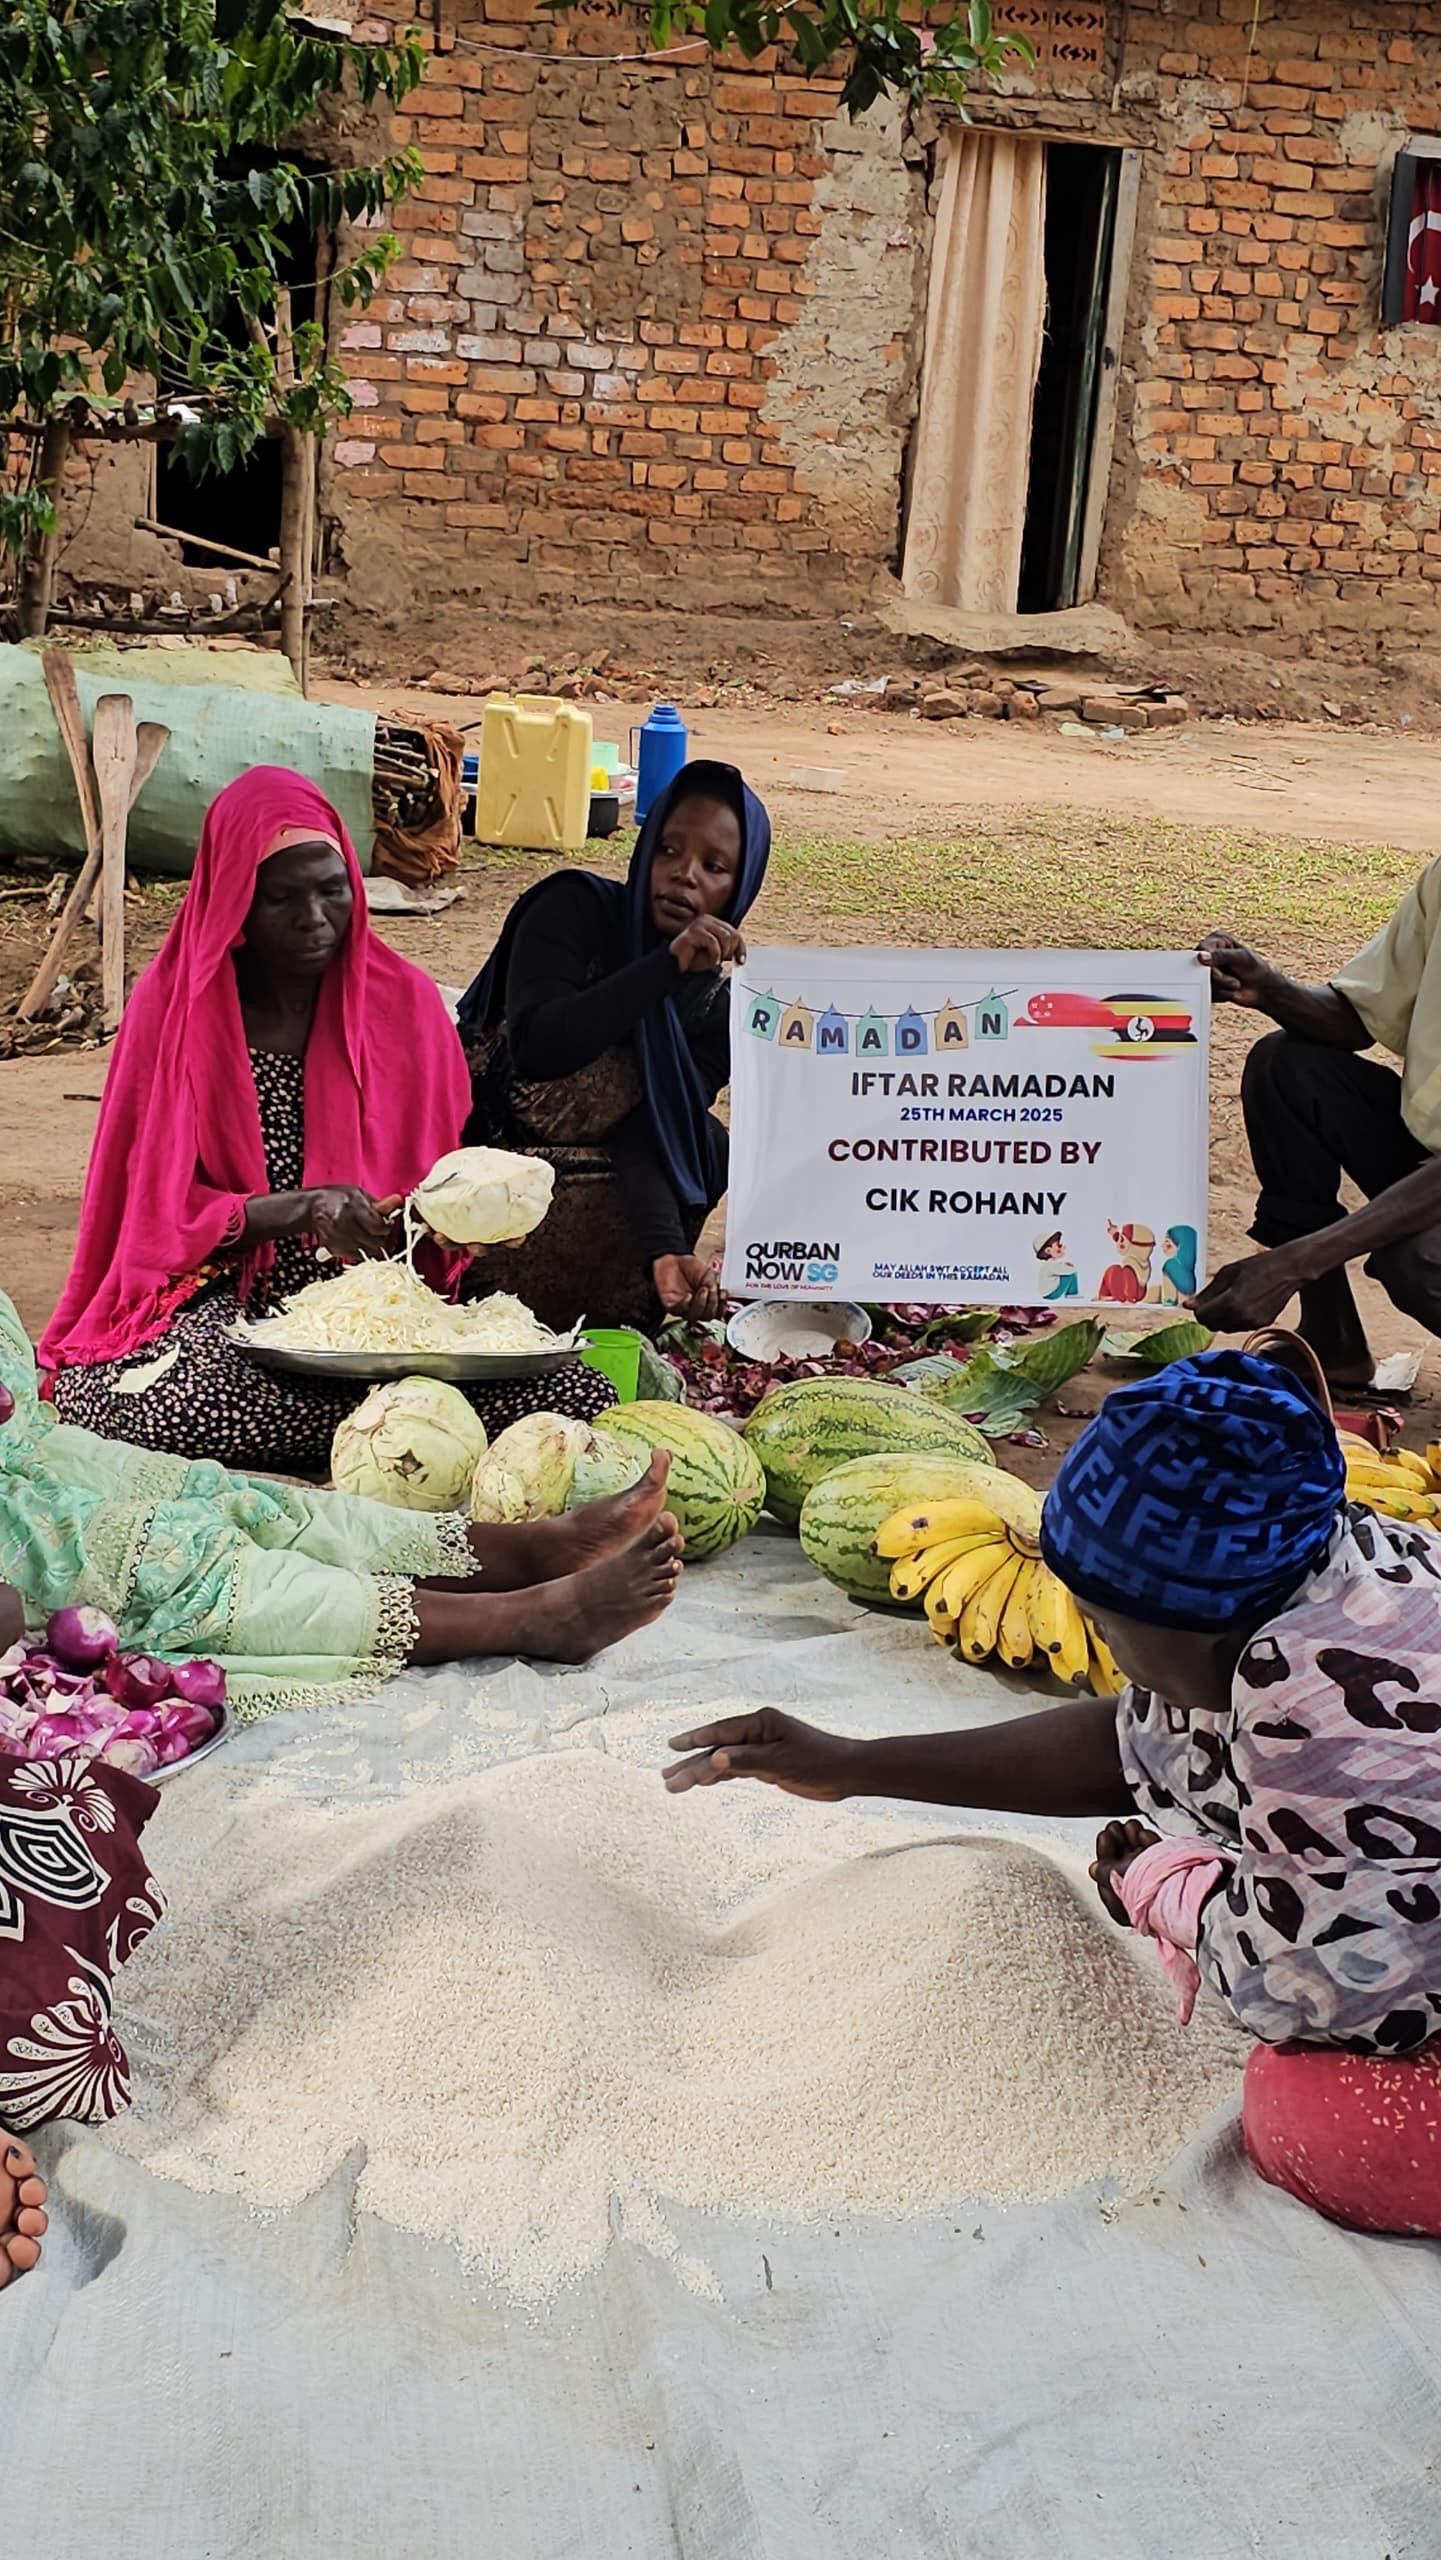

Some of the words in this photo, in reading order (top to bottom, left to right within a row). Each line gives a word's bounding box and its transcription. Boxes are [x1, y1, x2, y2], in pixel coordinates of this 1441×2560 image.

[751, 1008, 1001, 1049] RAMADAN
[851, 1071, 939, 1097] IFTAR
[947, 1073, 1115, 1098] RAMADAN
[900, 1107, 945, 1121] 25TH
[949, 1108, 1016, 1122] MARCH
[1019, 1107, 1063, 1122] 2025
[827, 1139, 1052, 1164] CONTRIBUTED
[1060, 1141, 1102, 1165] BY
[865, 1188, 920, 1213] CIK
[928, 1189, 1068, 1216] ROHANY
[745, 1242, 840, 1262] QURBAN
[745, 1261, 805, 1281] NOW
[807, 1263, 838, 1282] SG
[874, 1263, 896, 1271] MAY
[898, 1264, 928, 1272] ALLAH
[929, 1265, 950, 1273] SWT
[953, 1265, 990, 1273] ACCEPT
[992, 1265, 1007, 1274] ALL
[894, 1271, 923, 1279] DEEDS
[938, 1272, 958, 1280] THIS
[960, 1273, 1009, 1281] RAMADAN
[760, 1282, 772, 1290] THE
